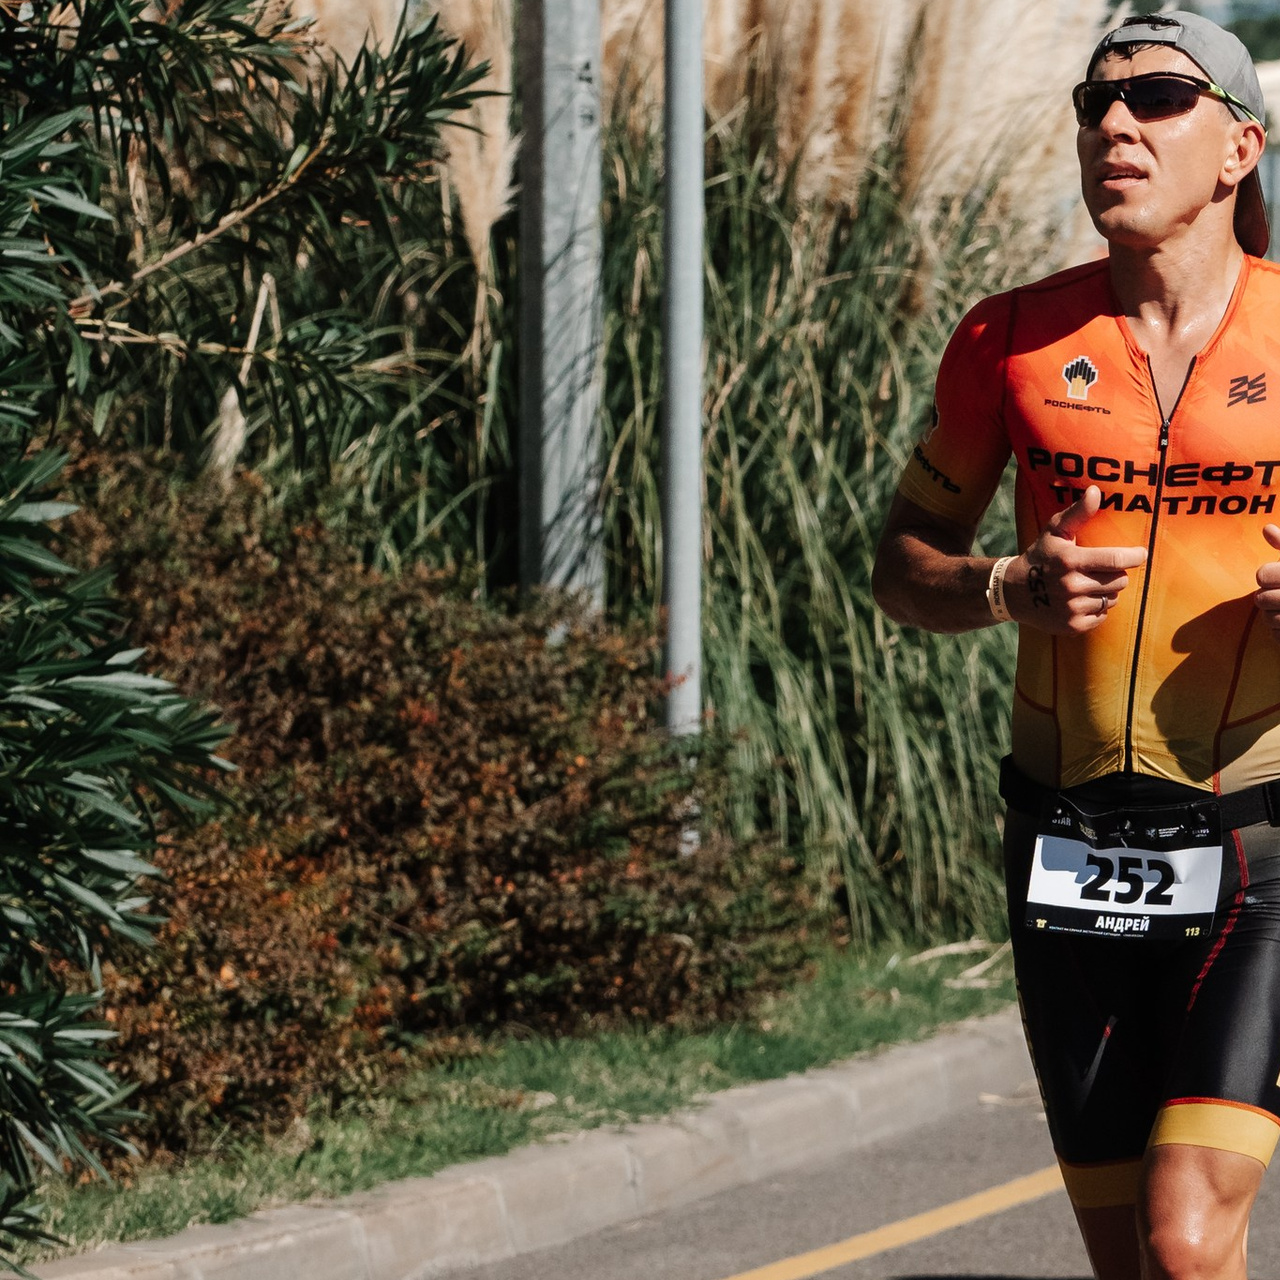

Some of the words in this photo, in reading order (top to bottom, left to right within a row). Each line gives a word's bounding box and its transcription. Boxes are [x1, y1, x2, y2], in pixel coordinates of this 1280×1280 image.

[1044, 398, 1111, 415] РОСНЕФТЬ
[1028, 565, 1051, 608] 252
[1080, 853, 1175, 905] 252
[1095, 915, 1150, 932] АНДРЕЙ
[1185, 927, 1200, 936] 113
